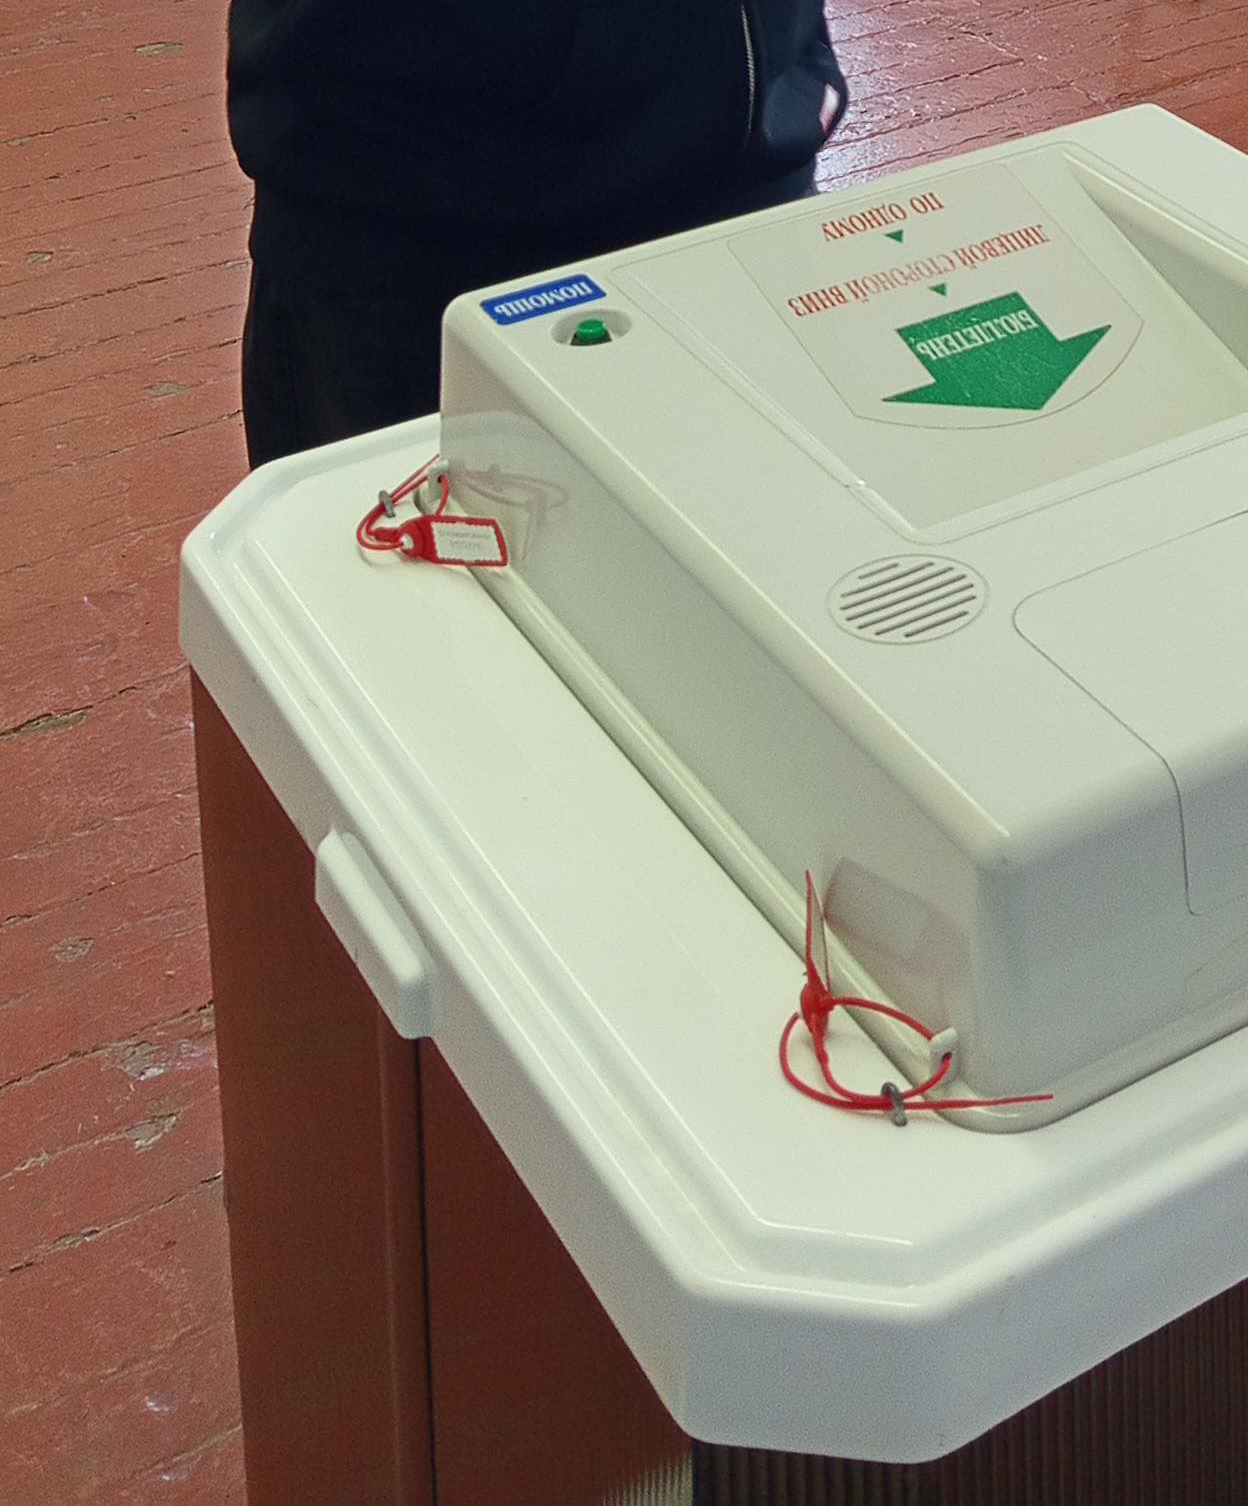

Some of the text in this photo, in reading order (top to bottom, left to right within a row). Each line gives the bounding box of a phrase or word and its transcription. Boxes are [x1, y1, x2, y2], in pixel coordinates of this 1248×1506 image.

[821, 192, 945, 242] ПО ОДНОМУ
[787, 223, 1051, 317] ЛИЦЕВОЙ СТОРОНОЙ ВНИЗ
[494, 281, 594, 317] ПОМОЩЬ
[916, 309, 1039, 361] БЮЛЛЕТЕНЬ
